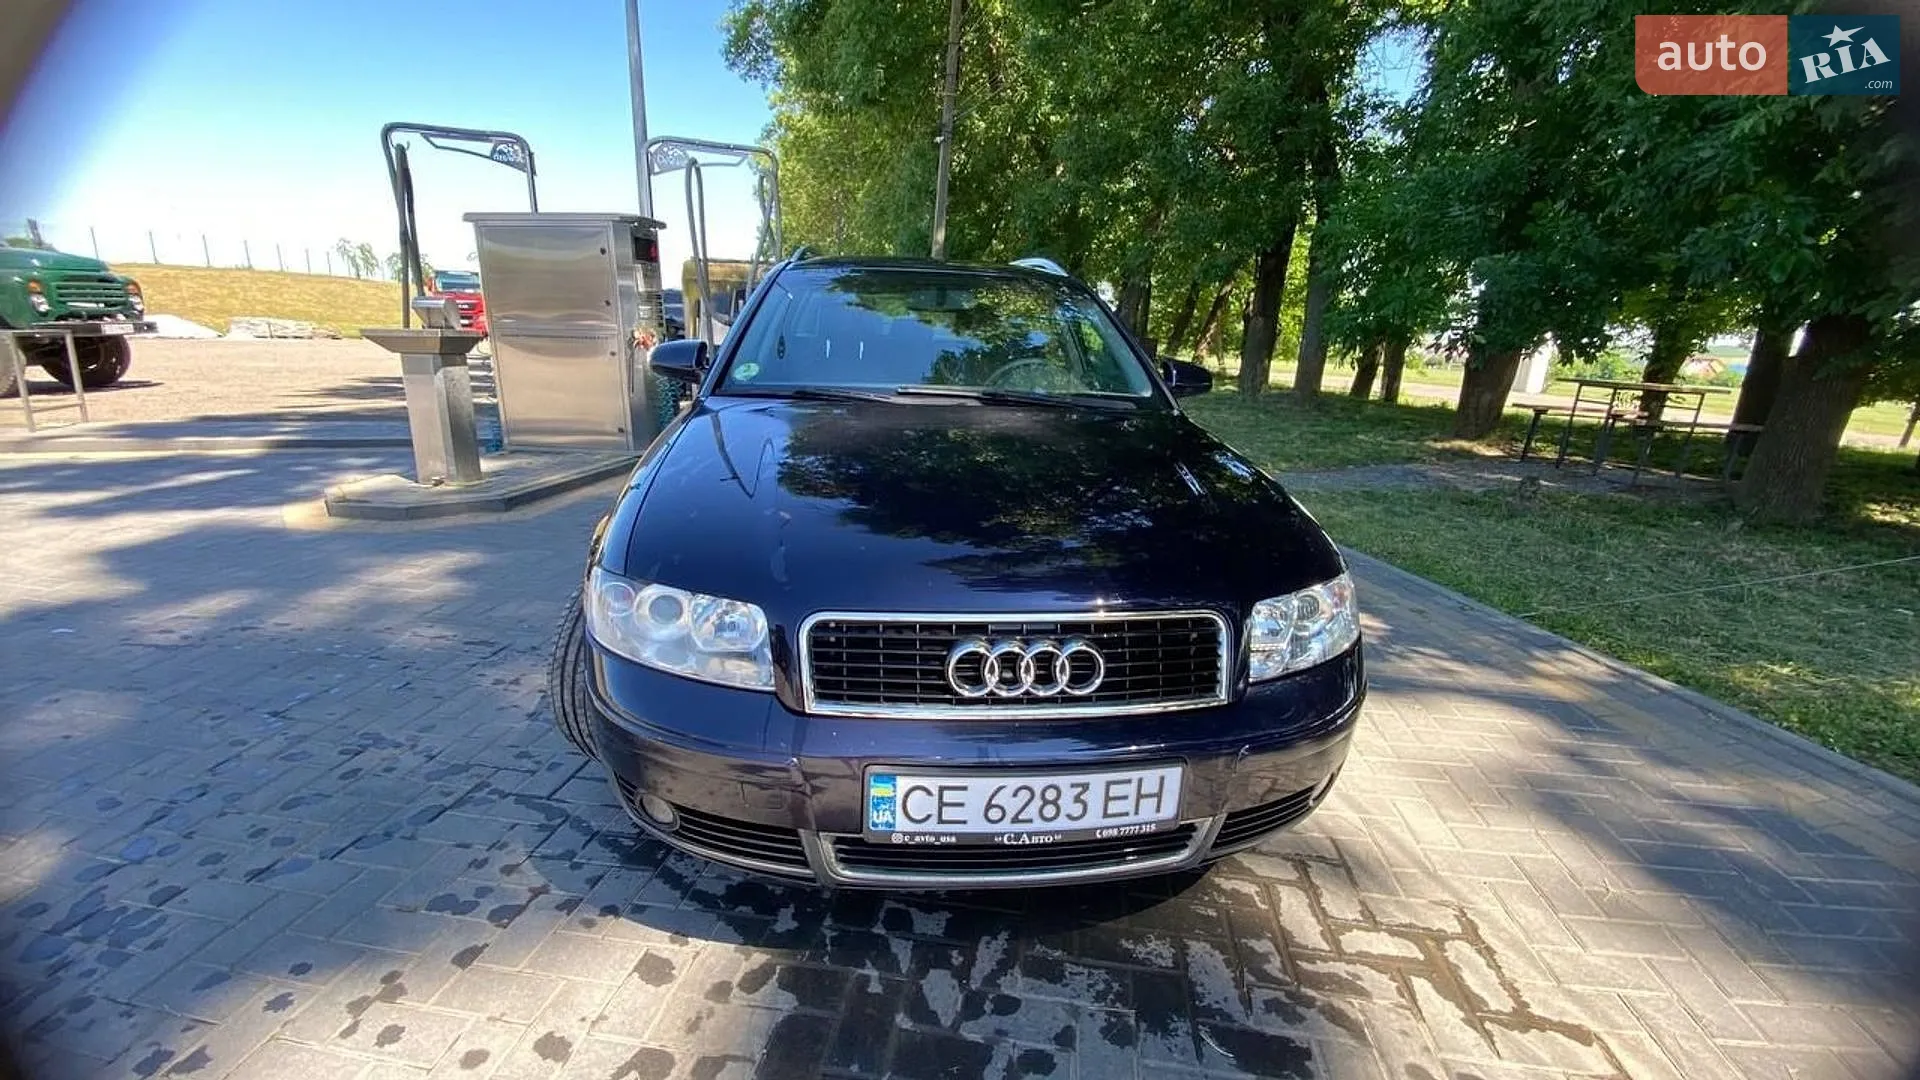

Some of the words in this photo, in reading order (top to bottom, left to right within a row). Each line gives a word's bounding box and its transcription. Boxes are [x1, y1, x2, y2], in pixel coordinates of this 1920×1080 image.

[902, 784, 968, 825] CE
[983, 781, 1091, 825] 6283
[1101, 775, 1166, 819] EH
[872, 811, 894, 824] UA
